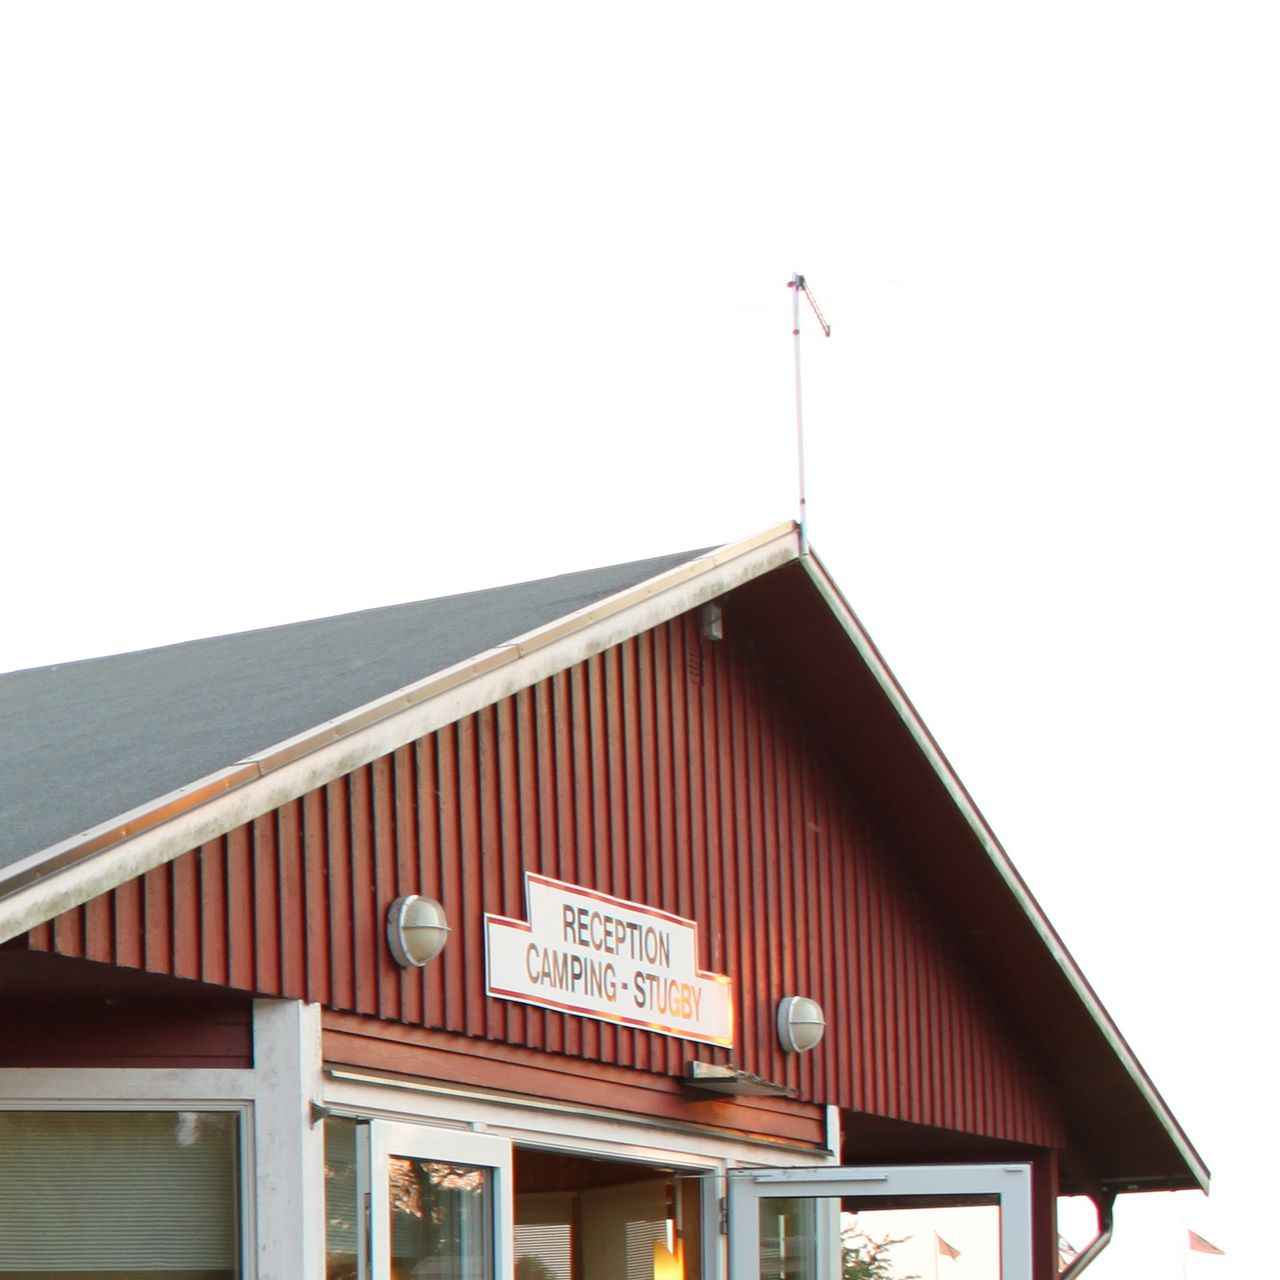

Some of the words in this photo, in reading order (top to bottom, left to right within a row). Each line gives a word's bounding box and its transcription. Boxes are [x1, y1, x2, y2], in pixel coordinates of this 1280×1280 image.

[562, 903, 671, 968] RECEPTION
[526, 942, 617, 1002] CAMPING
[633, 970, 702, 1022] STUGBY
